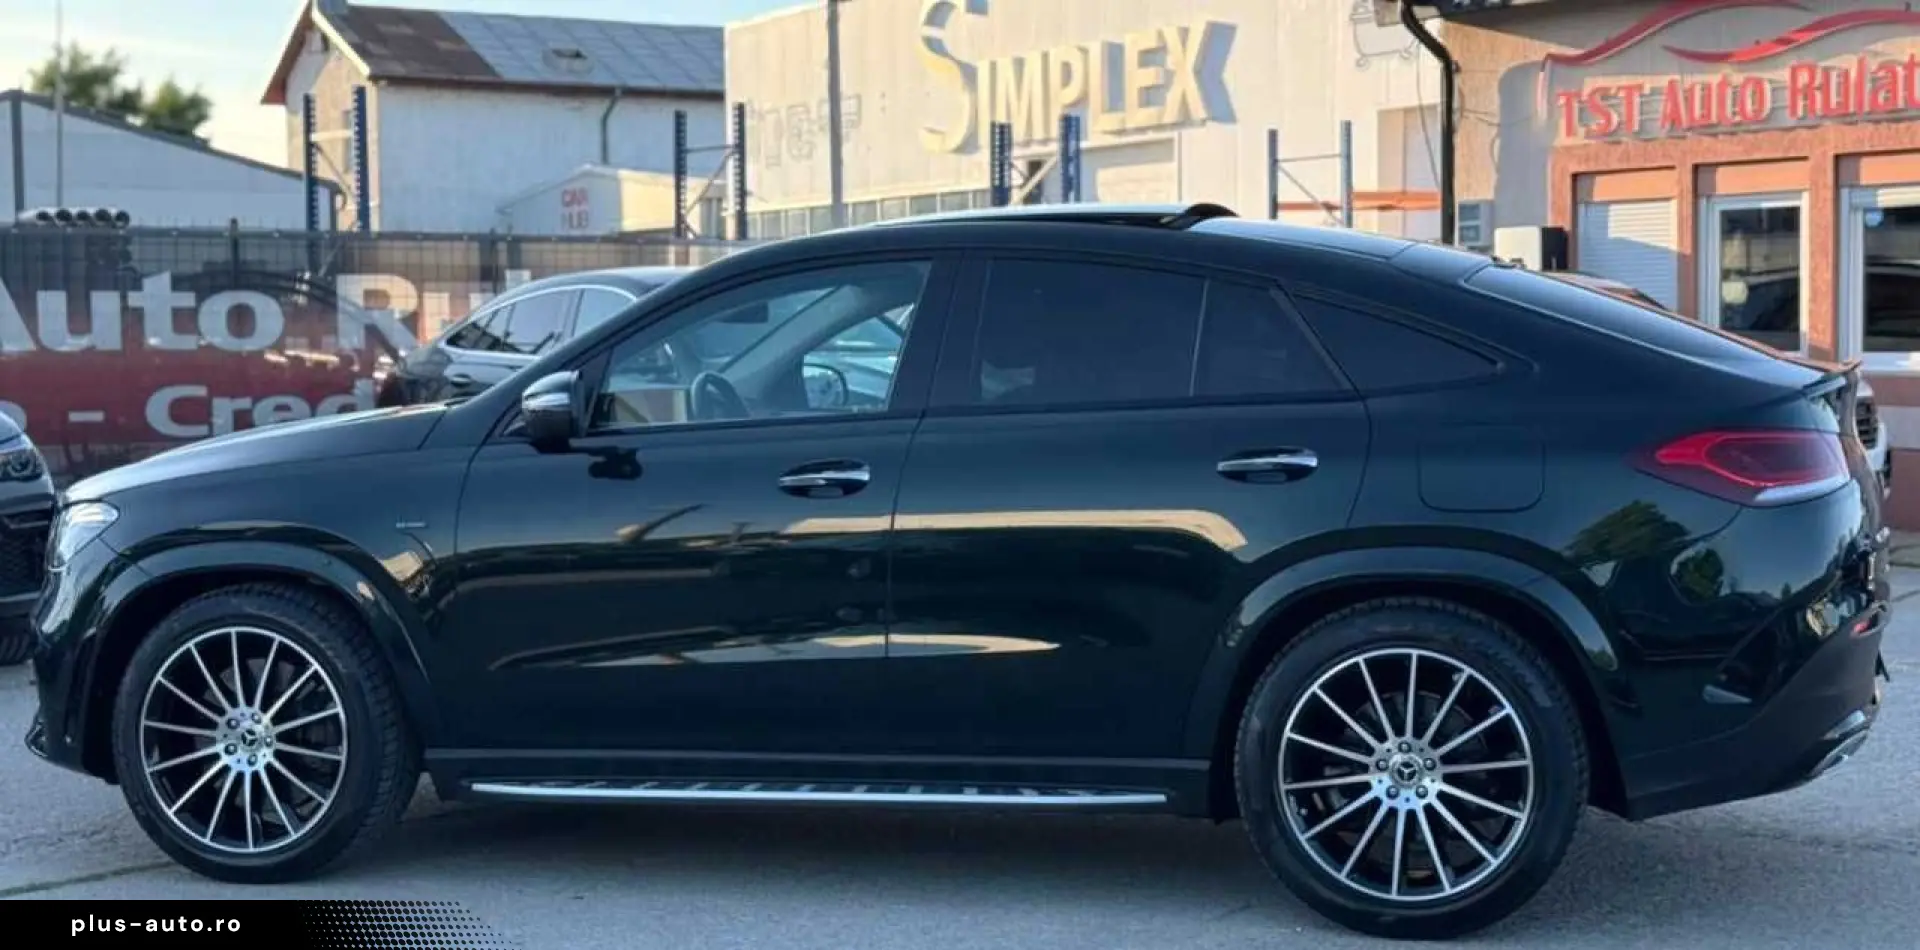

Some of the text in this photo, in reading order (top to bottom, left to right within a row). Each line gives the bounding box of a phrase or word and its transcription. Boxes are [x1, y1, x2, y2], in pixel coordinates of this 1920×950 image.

[917, 0, 1208, 153] SIMPLEX
[1556, 51, 1920, 138] TST Auto Rulat
